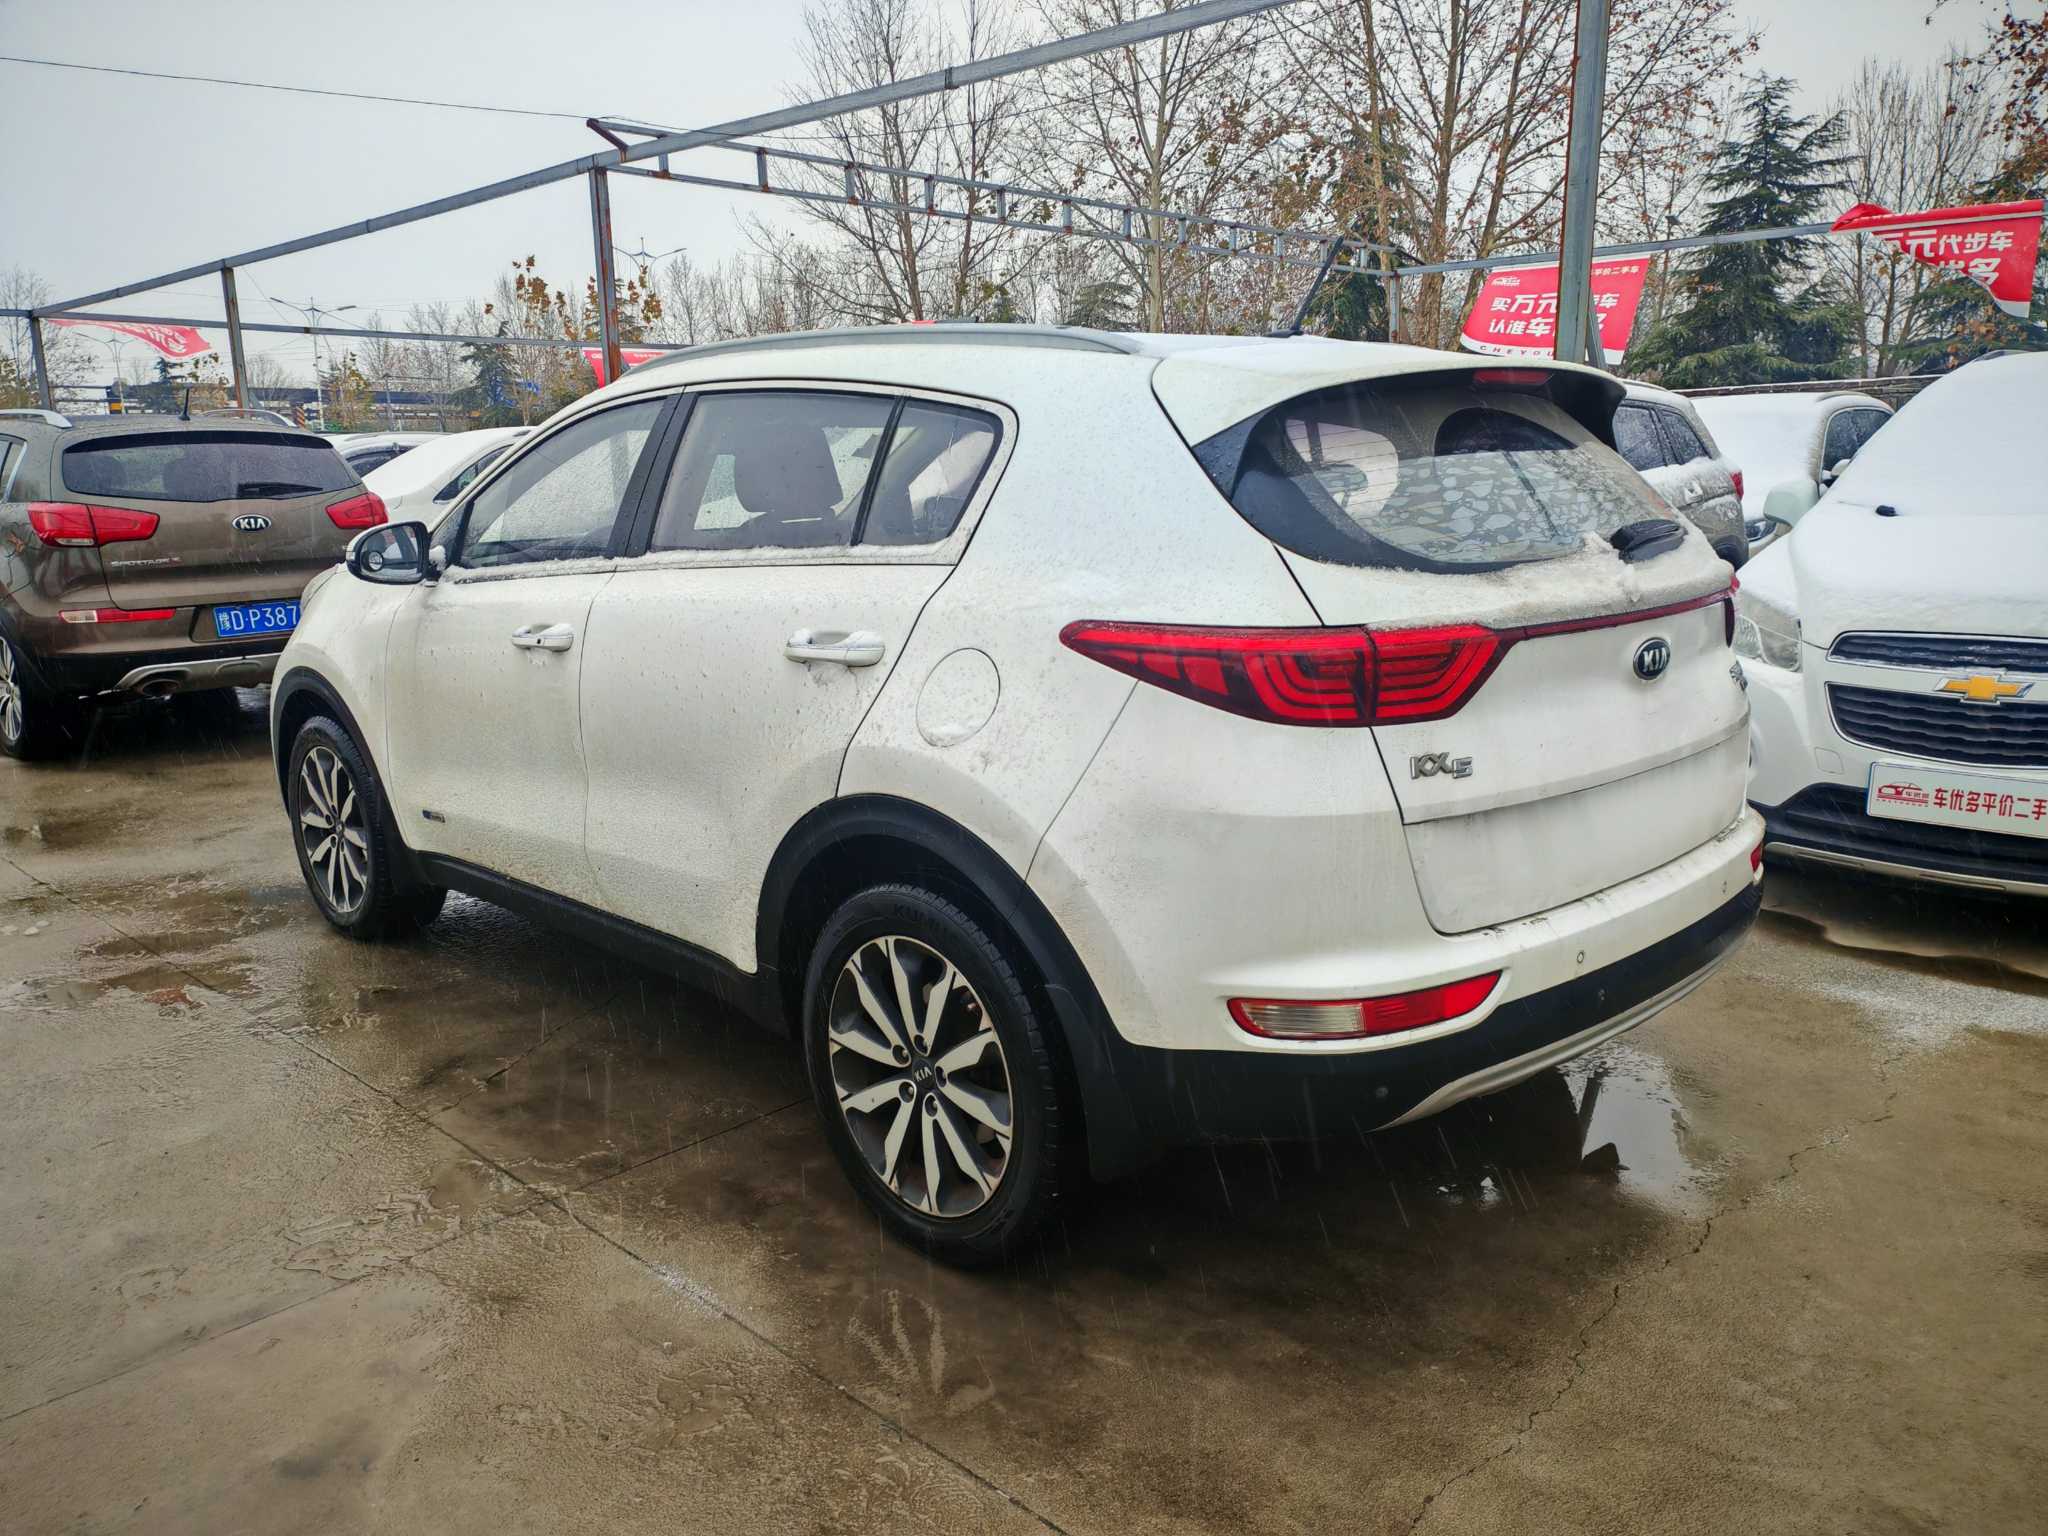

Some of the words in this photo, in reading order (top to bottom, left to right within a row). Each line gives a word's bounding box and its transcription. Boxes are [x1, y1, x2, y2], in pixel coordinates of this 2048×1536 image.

[1933, 787, 2048, 820] 车优多平价二手
[914, 1066, 932, 1082] KIA
